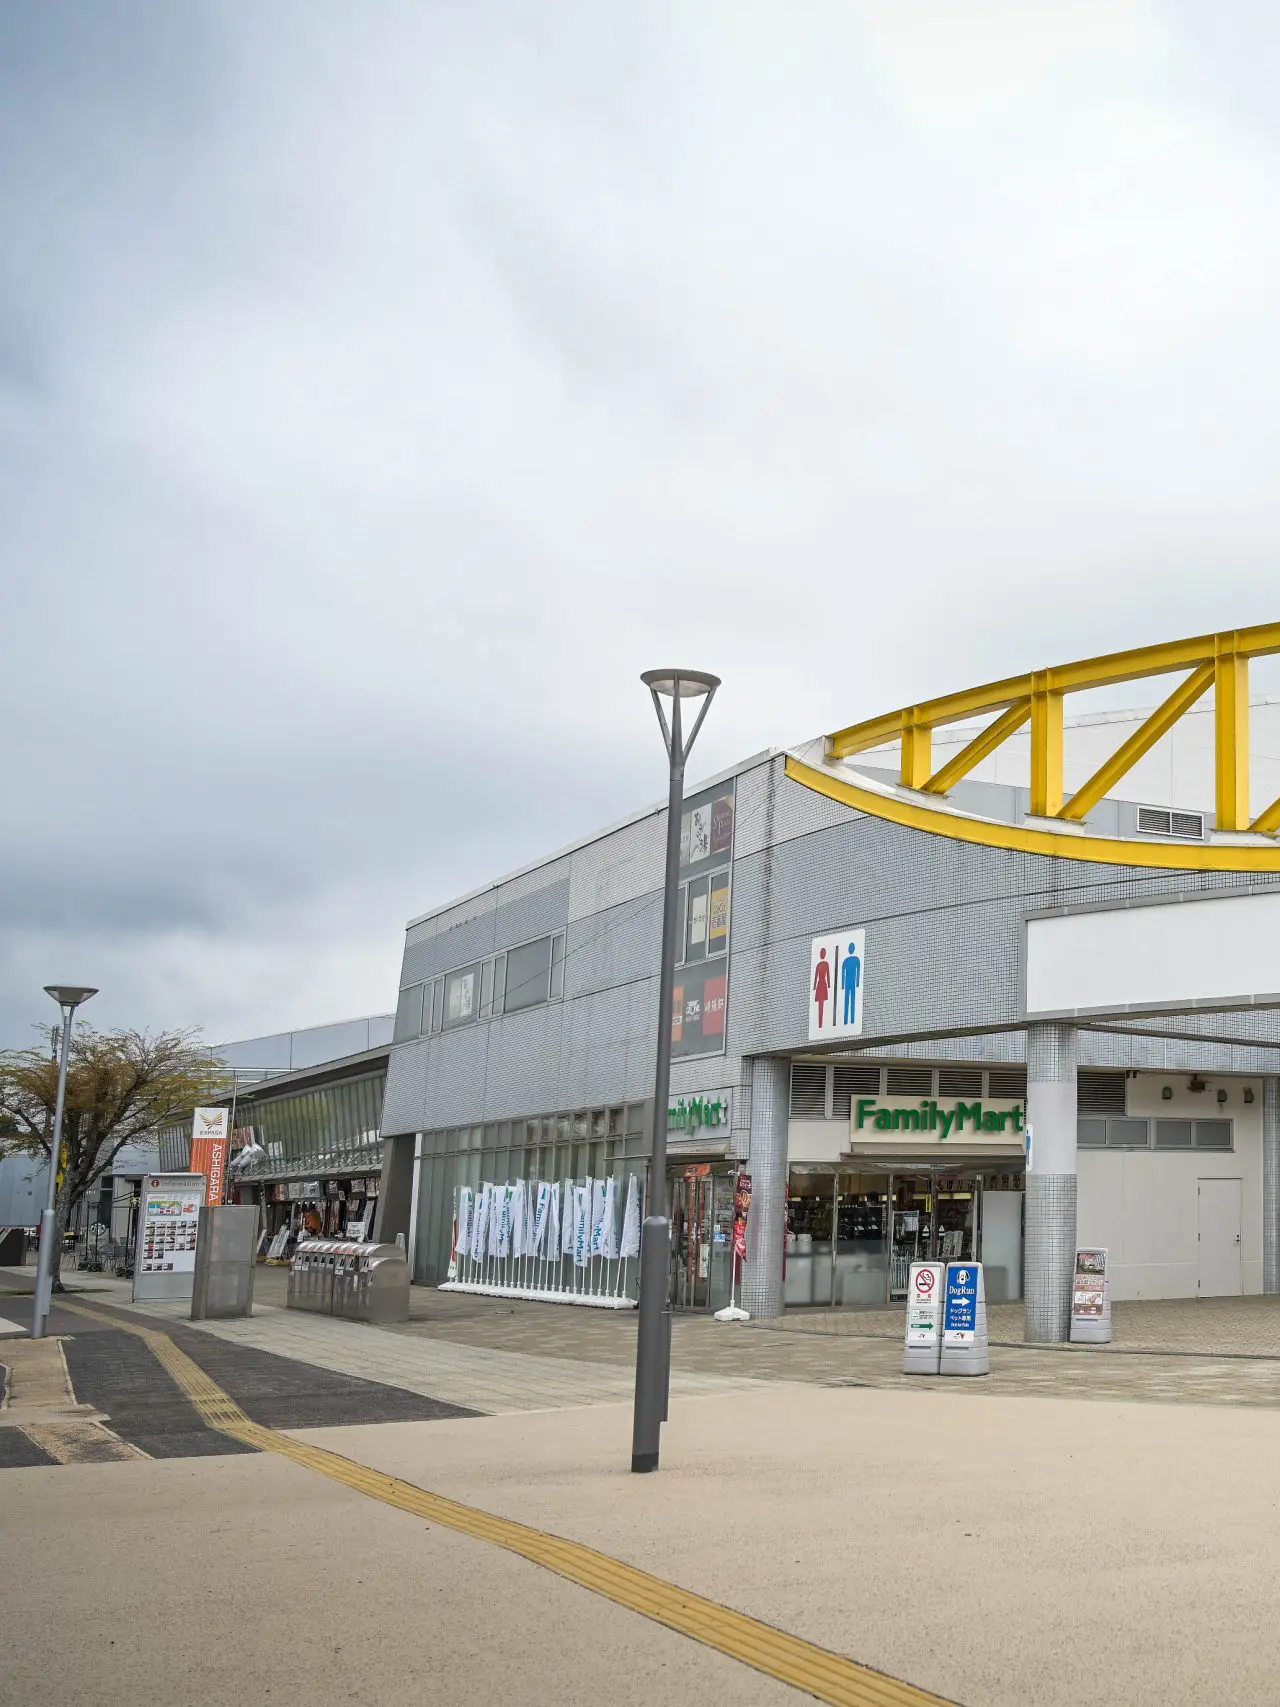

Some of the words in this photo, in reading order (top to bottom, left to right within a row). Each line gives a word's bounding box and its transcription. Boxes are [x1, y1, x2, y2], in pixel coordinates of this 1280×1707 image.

[857, 1099, 1024, 1139] FamilyMart
[208, 1143, 222, 1201] ASHIGARA
[576, 1213, 585, 1262] amilyMart
